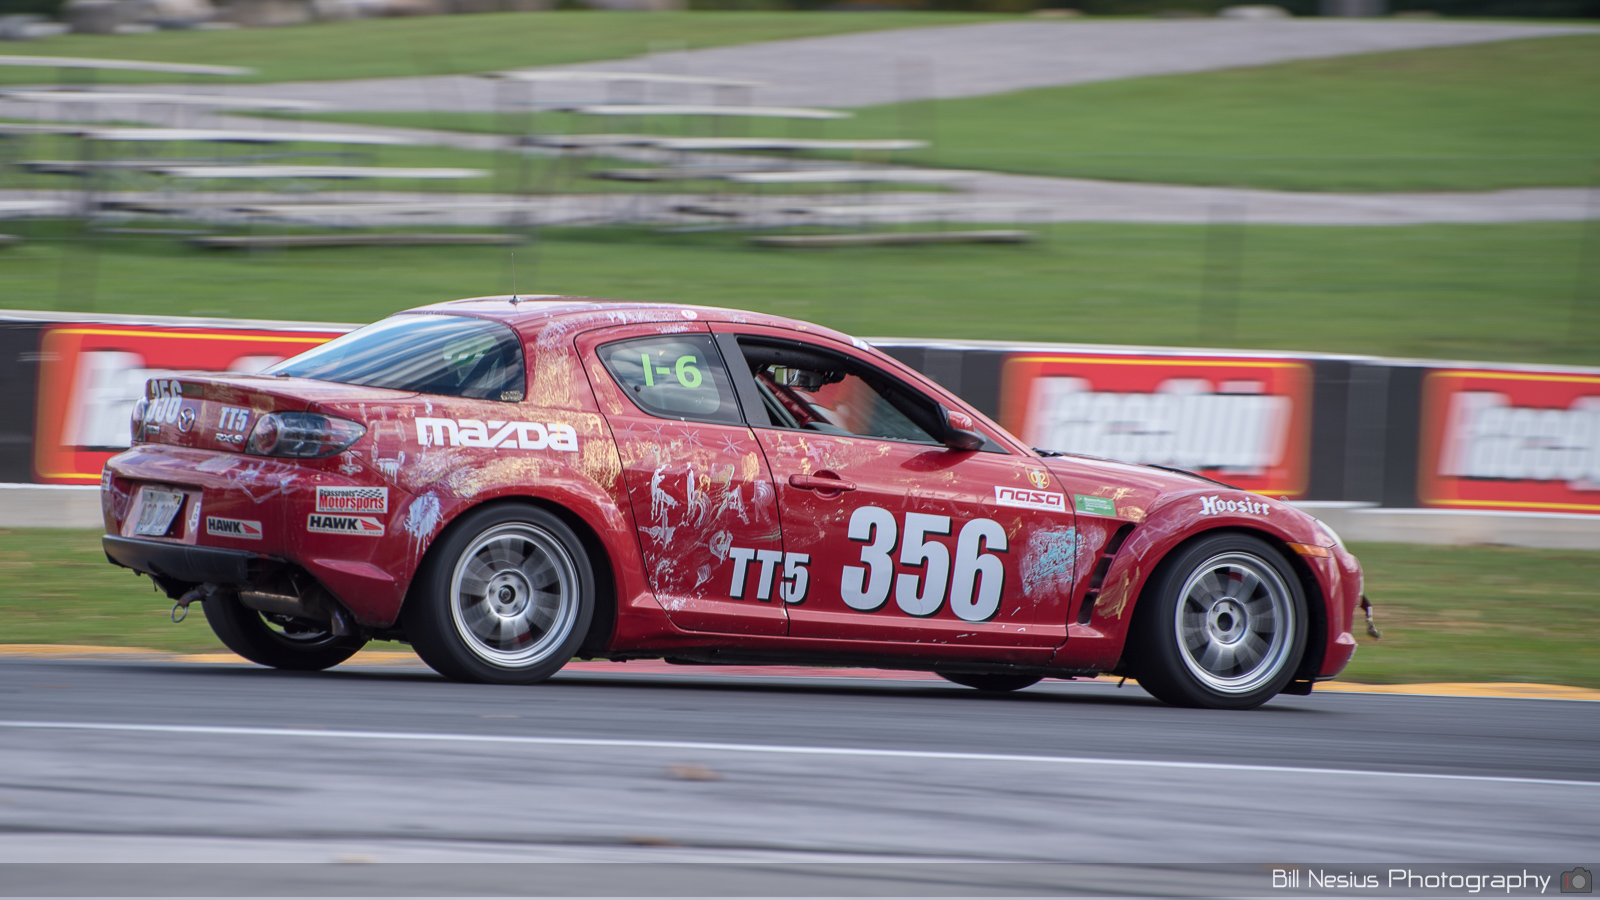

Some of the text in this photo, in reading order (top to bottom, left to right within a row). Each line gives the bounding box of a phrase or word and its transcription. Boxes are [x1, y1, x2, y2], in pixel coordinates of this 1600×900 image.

[145, 379, 183, 425] 356
[218, 406, 250, 432] TT5
[1030, 471, 1048, 485] 02
[319, 488, 356, 497] Grassroots
[319, 495, 385, 511] Motorsports
[1198, 495, 1271, 516] Hoosier
[208, 517, 242, 534] HAWK
[309, 515, 359, 530] HAWK
[840, 506, 1008, 622] 356
[729, 547, 811, 605] TT5
